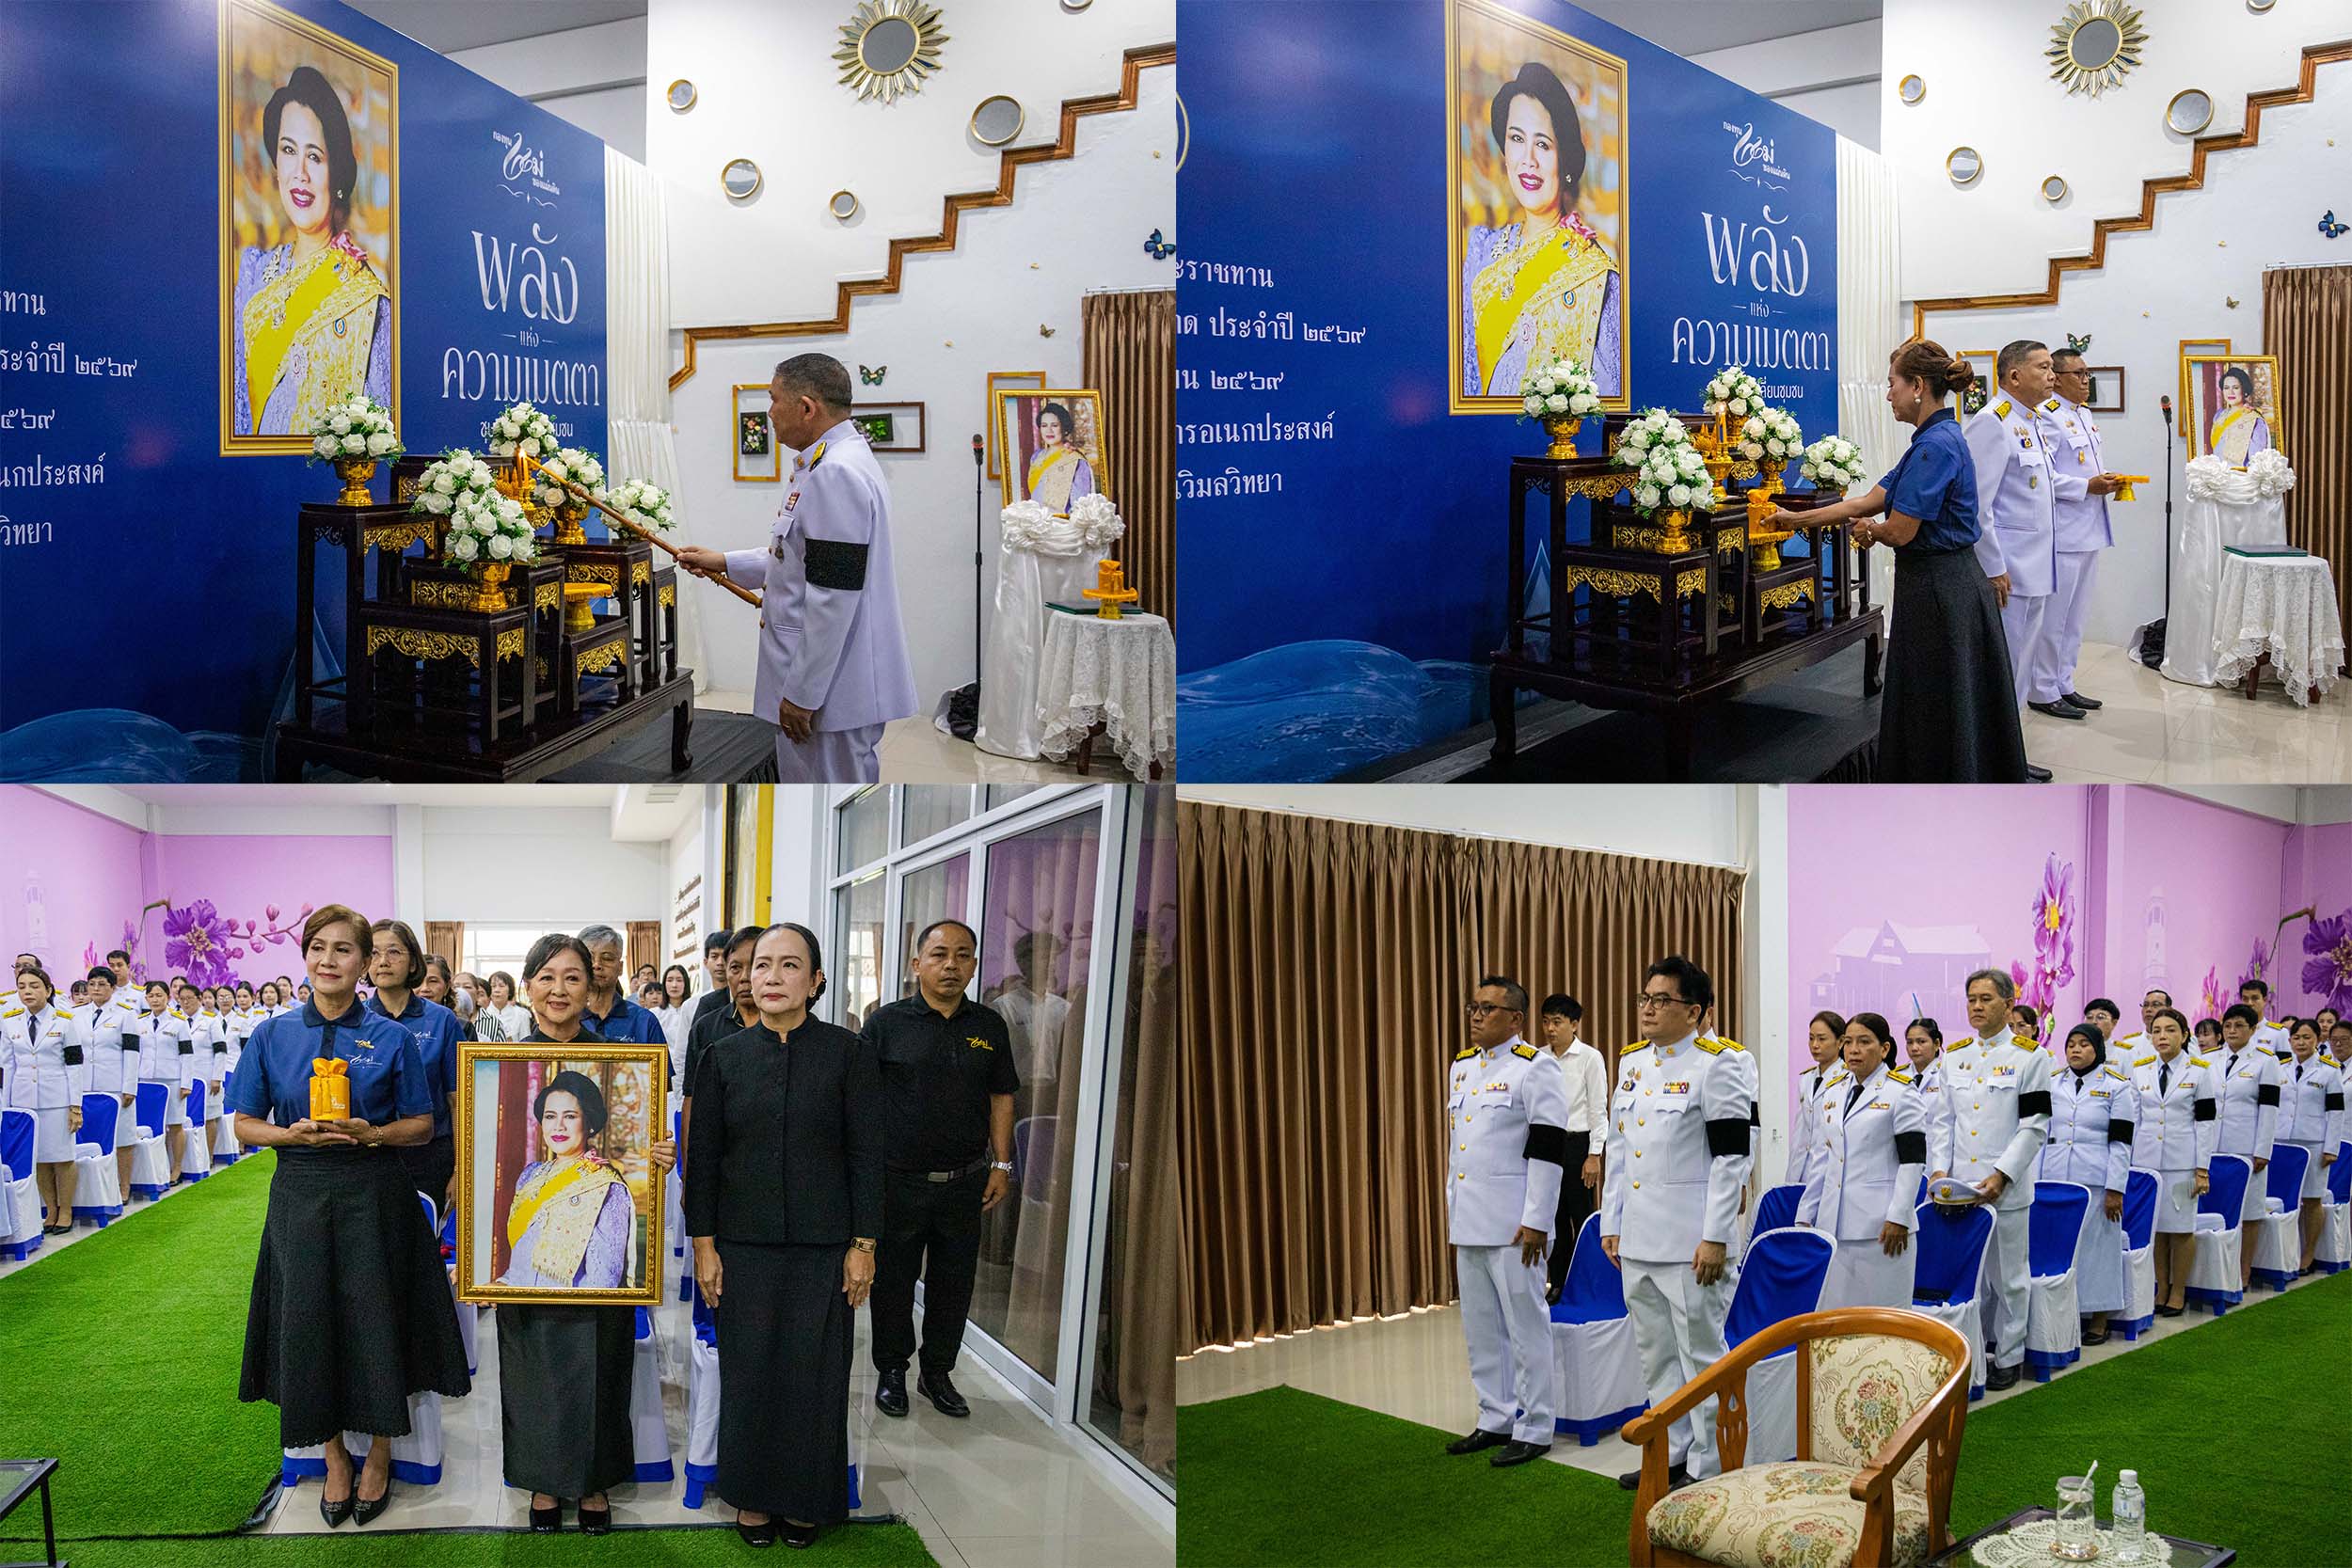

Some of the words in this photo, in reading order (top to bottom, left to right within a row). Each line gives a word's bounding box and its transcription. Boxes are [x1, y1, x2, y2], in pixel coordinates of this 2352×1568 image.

[1701, 204, 1809, 297] พลัง
[471, 222, 579, 325] พลัง
[1209, 306, 1294, 341] ประจำปี
[1303, 322, 1367, 344] ๒๕๖๙
[1749, 297, 1770, 318] แห่ง
[519, 325, 539, 348] แห่ง
[1671, 317, 1831, 372] ความเมตตา
[75, 354, 138, 378] ๒๕๖๙
[441, 346, 600, 406] ความเมตตา
[1210, 370, 1285, 390] ๒๕๖๙
